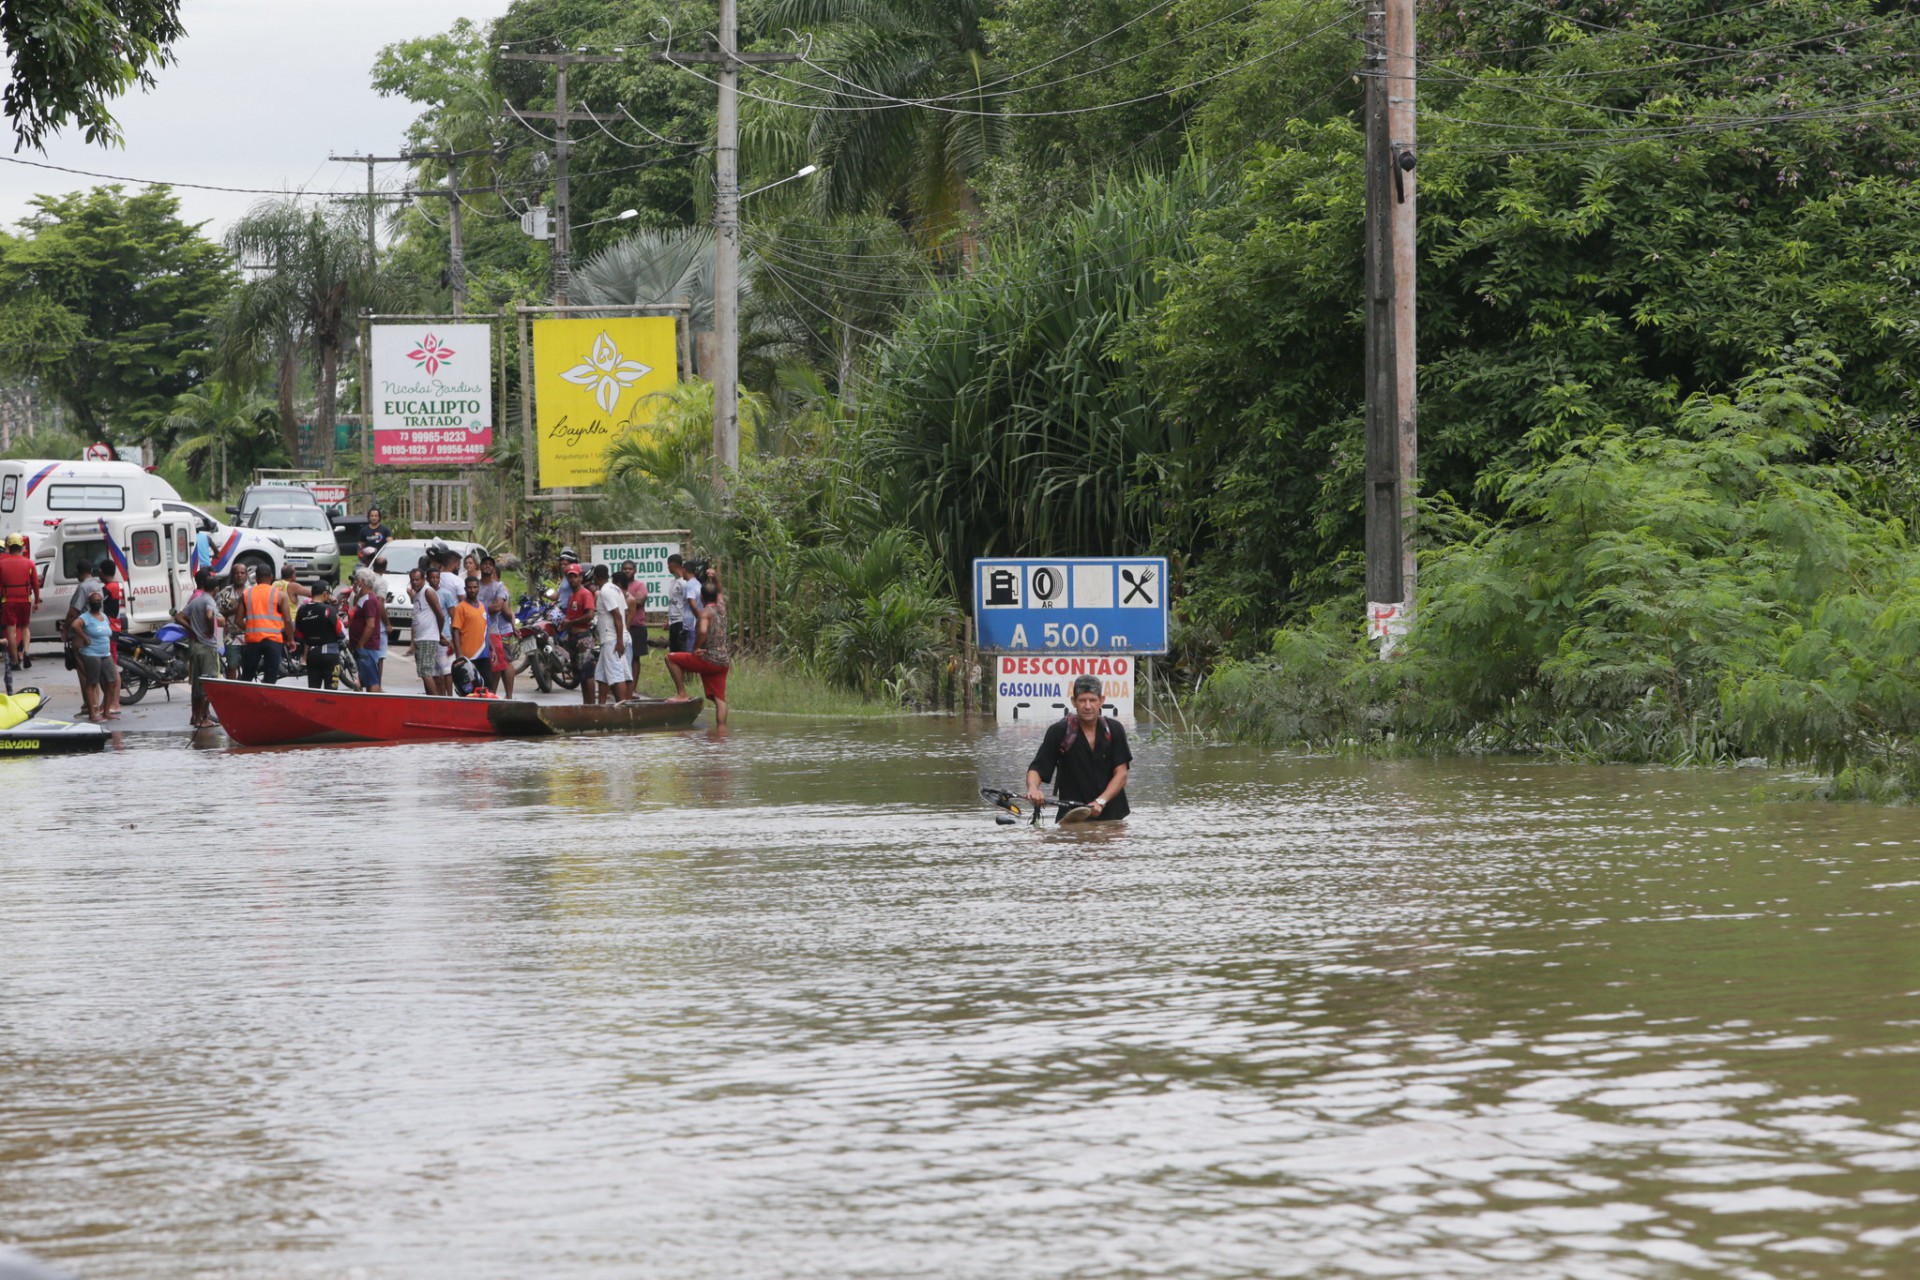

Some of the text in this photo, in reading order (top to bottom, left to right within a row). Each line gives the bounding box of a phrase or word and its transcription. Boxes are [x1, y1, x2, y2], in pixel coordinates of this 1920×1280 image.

[384, 400, 480, 415] EUCALIPTO
[403, 416, 462, 426] TRATADO
[400, 431, 466, 443] 73 99965-0233
[603, 547, 668, 560] EUCALIPTO
[609, 561, 663, 574] TRTADO
[1042, 601, 1053, 609] AR
[1010, 623, 1029, 648] A
[1044, 623, 1099, 648] 500
[1002, 656, 1128, 676] DESCONTÃO
[999, 682, 1061, 697] GASOLINA
